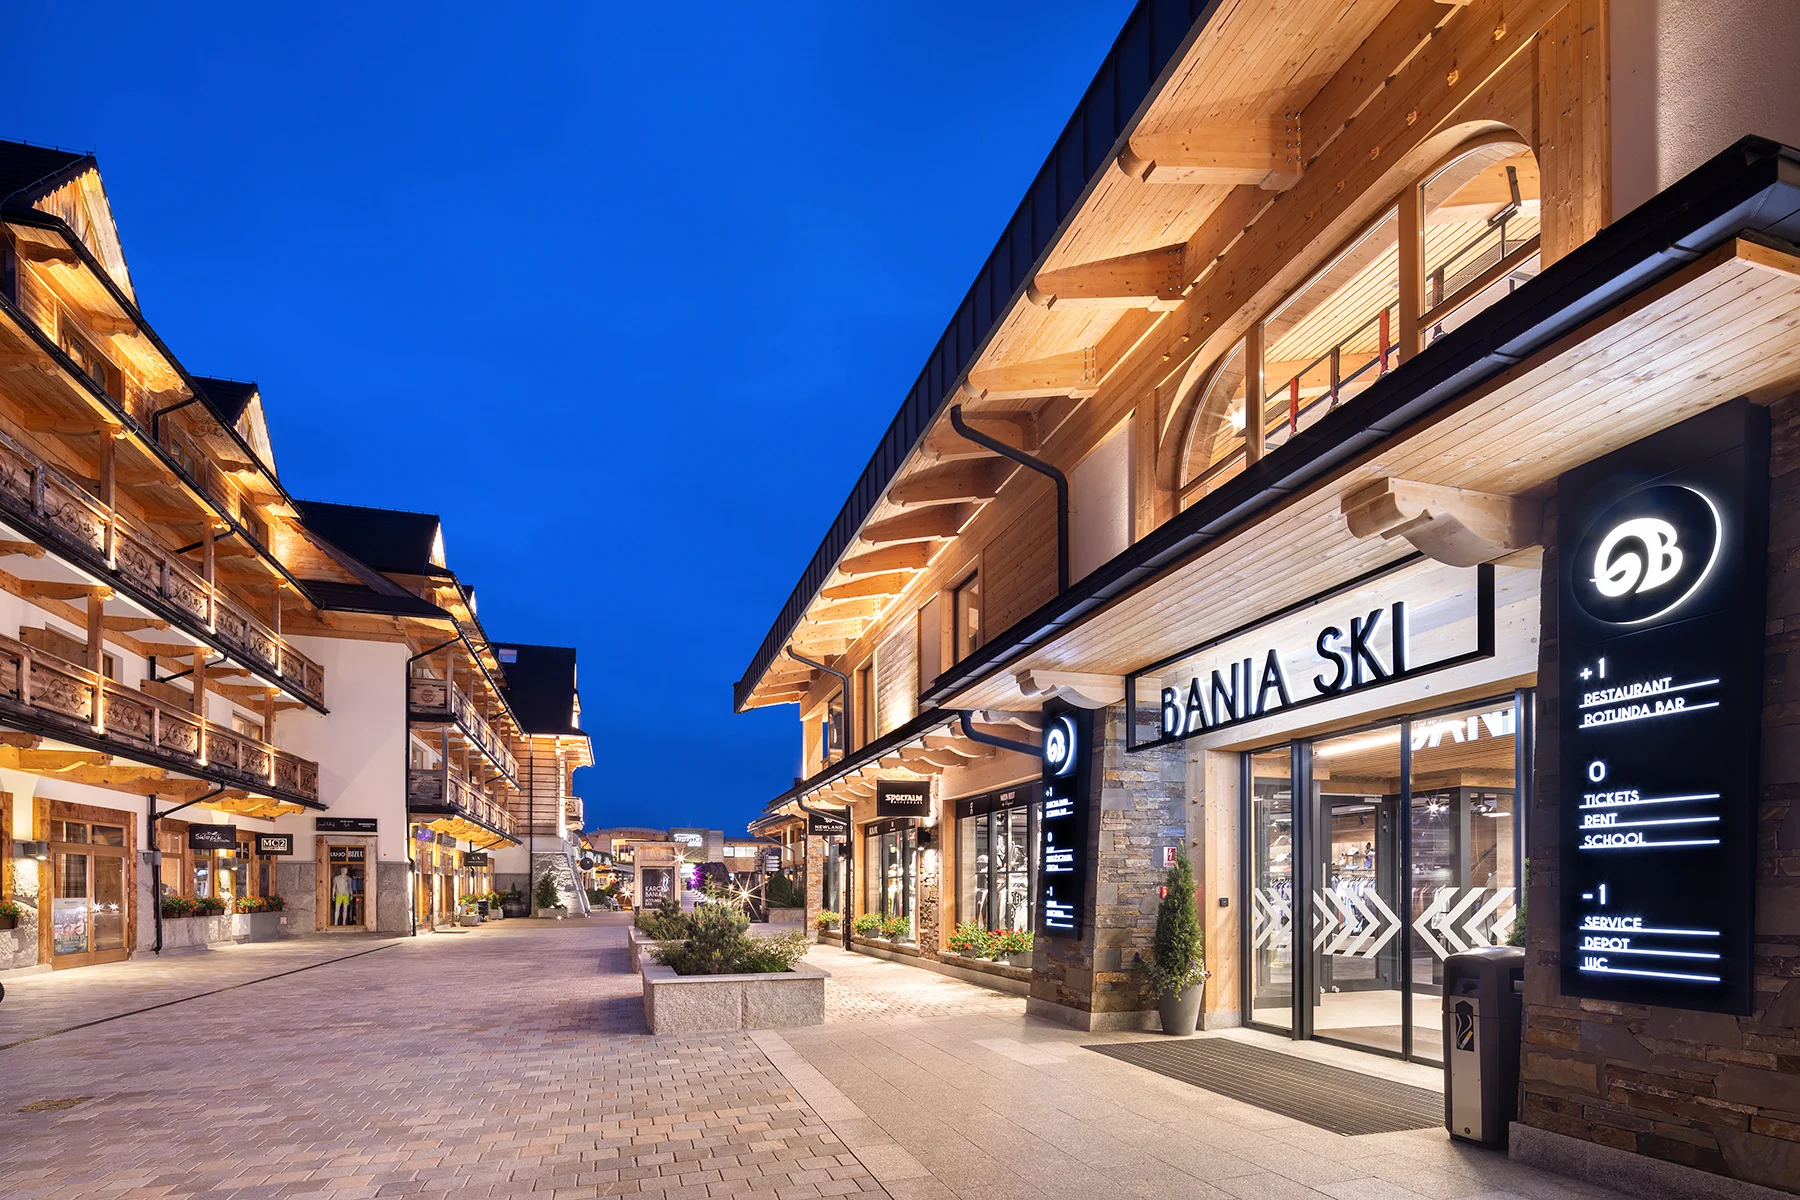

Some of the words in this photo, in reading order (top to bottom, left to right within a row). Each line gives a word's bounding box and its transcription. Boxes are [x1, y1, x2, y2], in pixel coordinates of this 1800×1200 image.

[1160, 648, 1295, 741] BANIA
[1312, 600, 1410, 696] SKI
[1580, 658, 1606, 680] +1
[1583, 677, 1673, 706] RESTAURANT
[1583, 704, 1651, 727] ROTUNDA
[1655, 697, 1686, 714] BAR
[1588, 760, 1606, 783] 0
[1583, 789, 1640, 805] TICKETS
[1584, 813, 1618, 827] RENT
[1583, 832, 1647, 847] SCHOOL
[1582, 883, 1607, 905] -1
[1583, 915, 1643, 930] SERVICE
[1584, 936, 1631, 951] DEPOT
